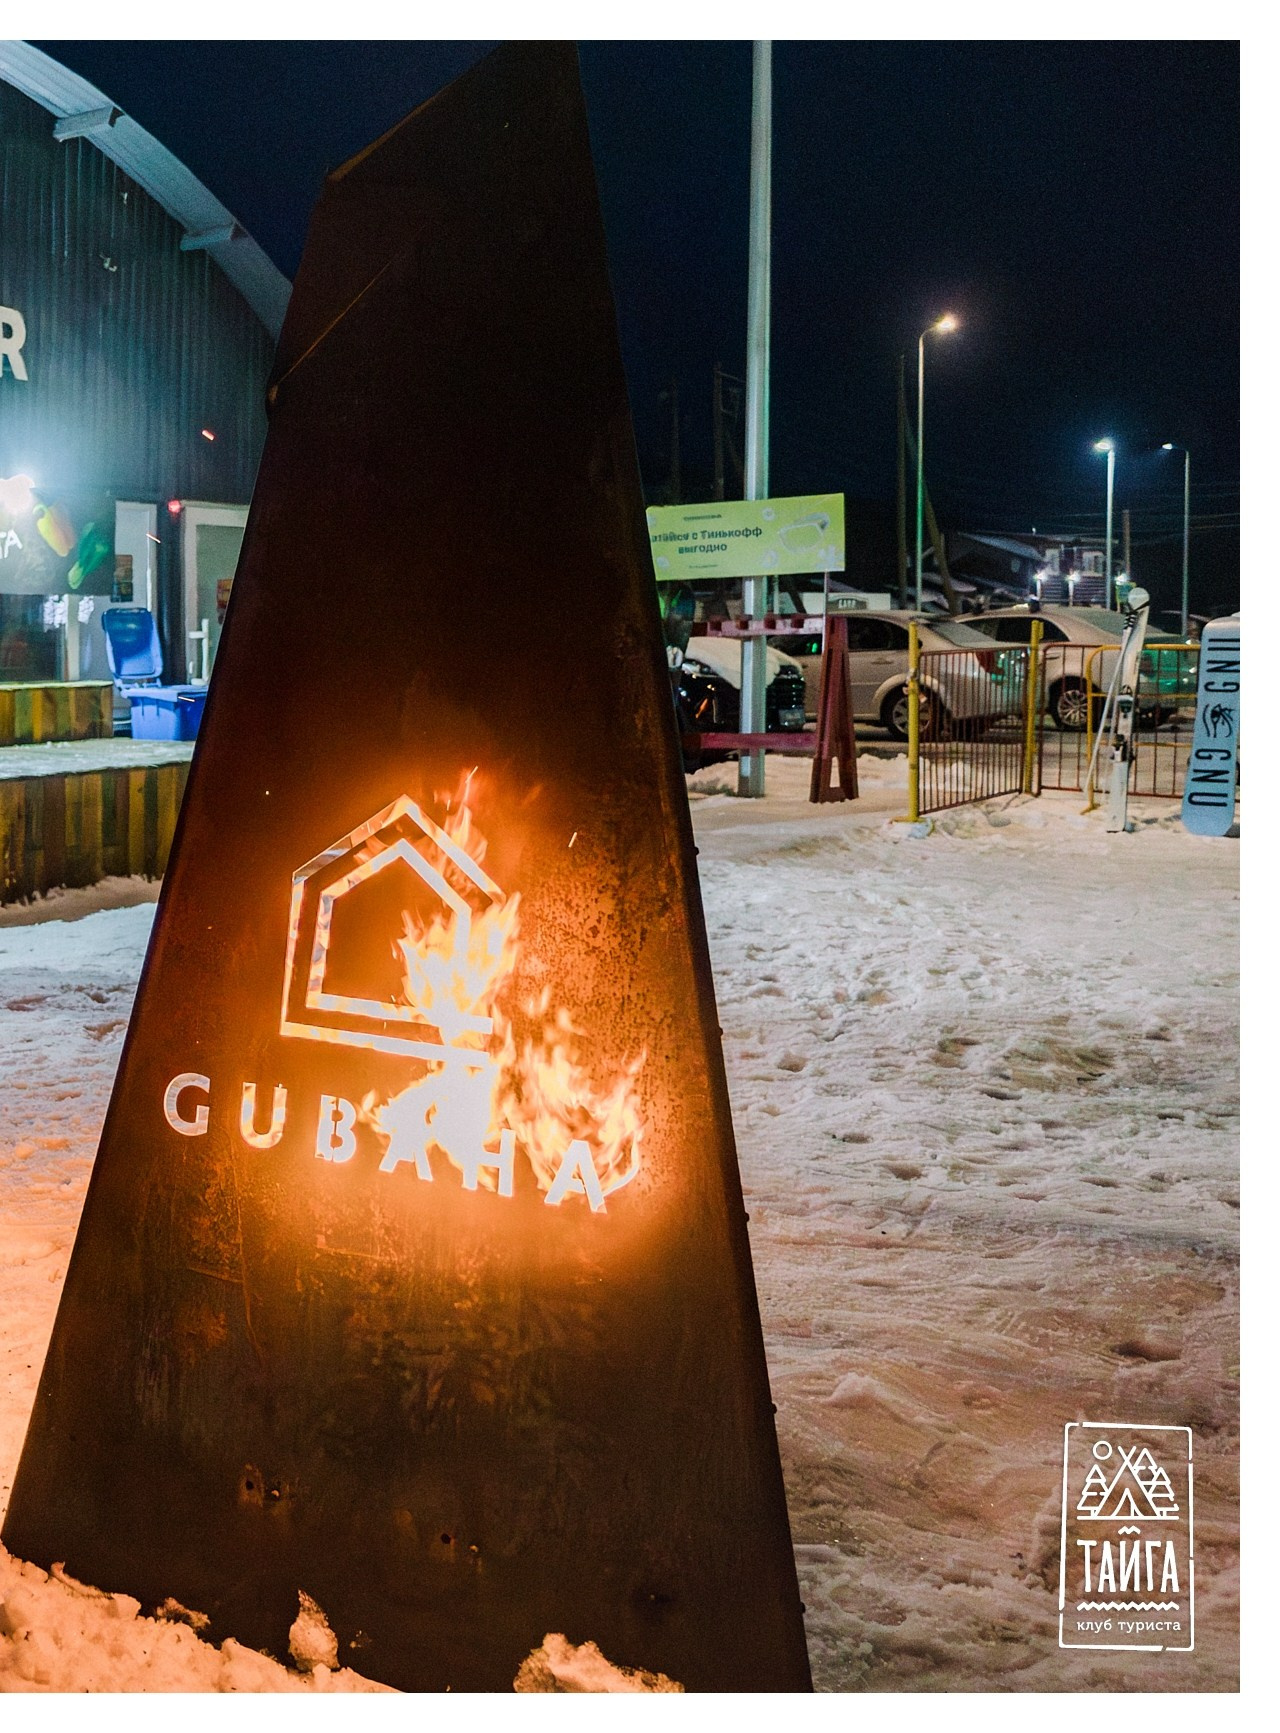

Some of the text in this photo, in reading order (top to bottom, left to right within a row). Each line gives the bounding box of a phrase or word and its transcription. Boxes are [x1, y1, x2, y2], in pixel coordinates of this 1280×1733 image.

[678, 543, 728, 554] выгодно
[700, 526, 763, 540] Тинькофф
[1187, 748, 1232, 808] GNU
[163, 1072, 608, 1214] GUBAHA
